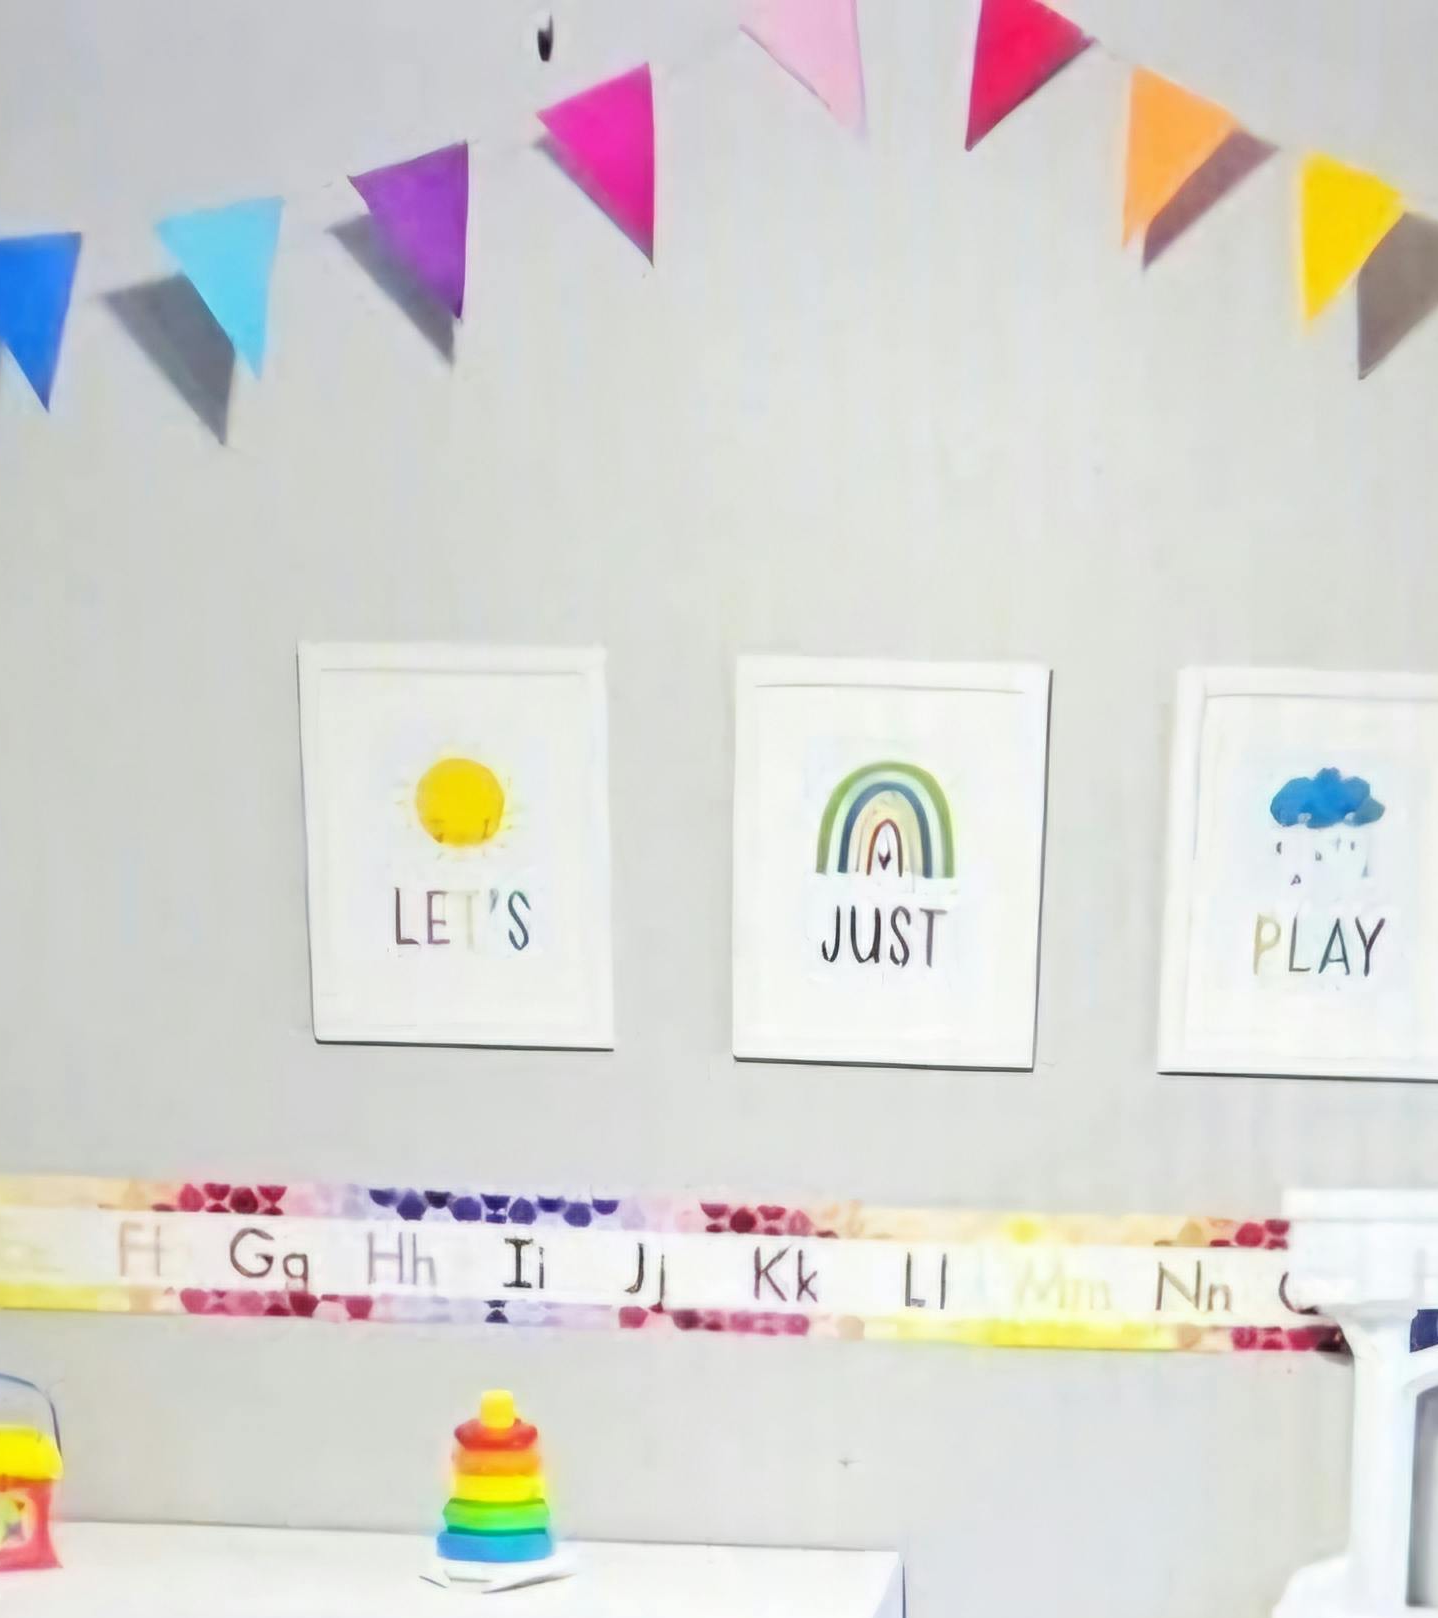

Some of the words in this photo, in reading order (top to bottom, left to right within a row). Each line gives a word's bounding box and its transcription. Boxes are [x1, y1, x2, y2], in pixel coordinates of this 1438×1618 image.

[394, 886, 532, 951] LET'S
[821, 905, 948, 968] JUST
[1252, 912, 1386, 977] PLAY
[229, 1226, 309, 1294] Gg
[367, 1230, 437, 1286] Hh
[503, 1236, 546, 1289] Ii
[624, 1241, 667, 1310] Jj
[752, 1244, 819, 1303] Kk
[904, 1250, 949, 1311] Ll
[1155, 1259, 1233, 1313] Nn
